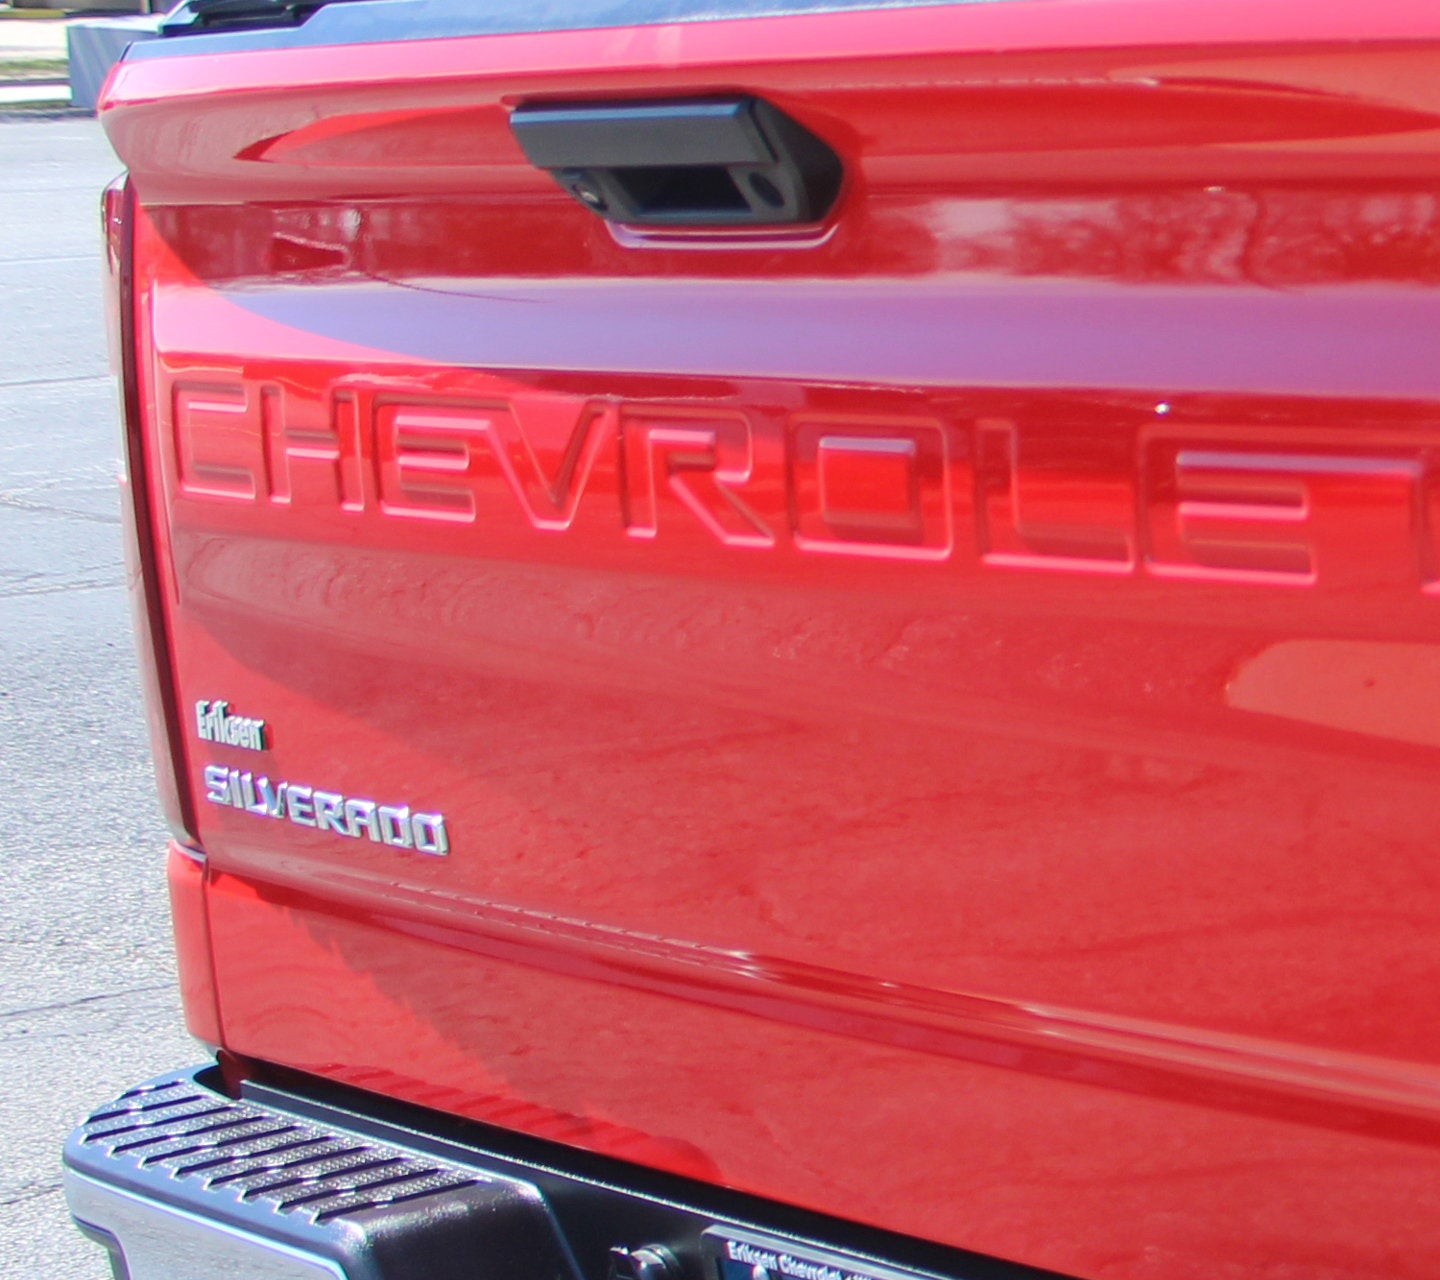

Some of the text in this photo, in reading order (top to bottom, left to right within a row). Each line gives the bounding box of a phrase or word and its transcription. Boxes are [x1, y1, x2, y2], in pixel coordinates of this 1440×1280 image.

[195, 699, 266, 751] Eriksen
[205, 764, 450, 856] SILVERADO
[727, 1241, 777, 1271] Eriksen
